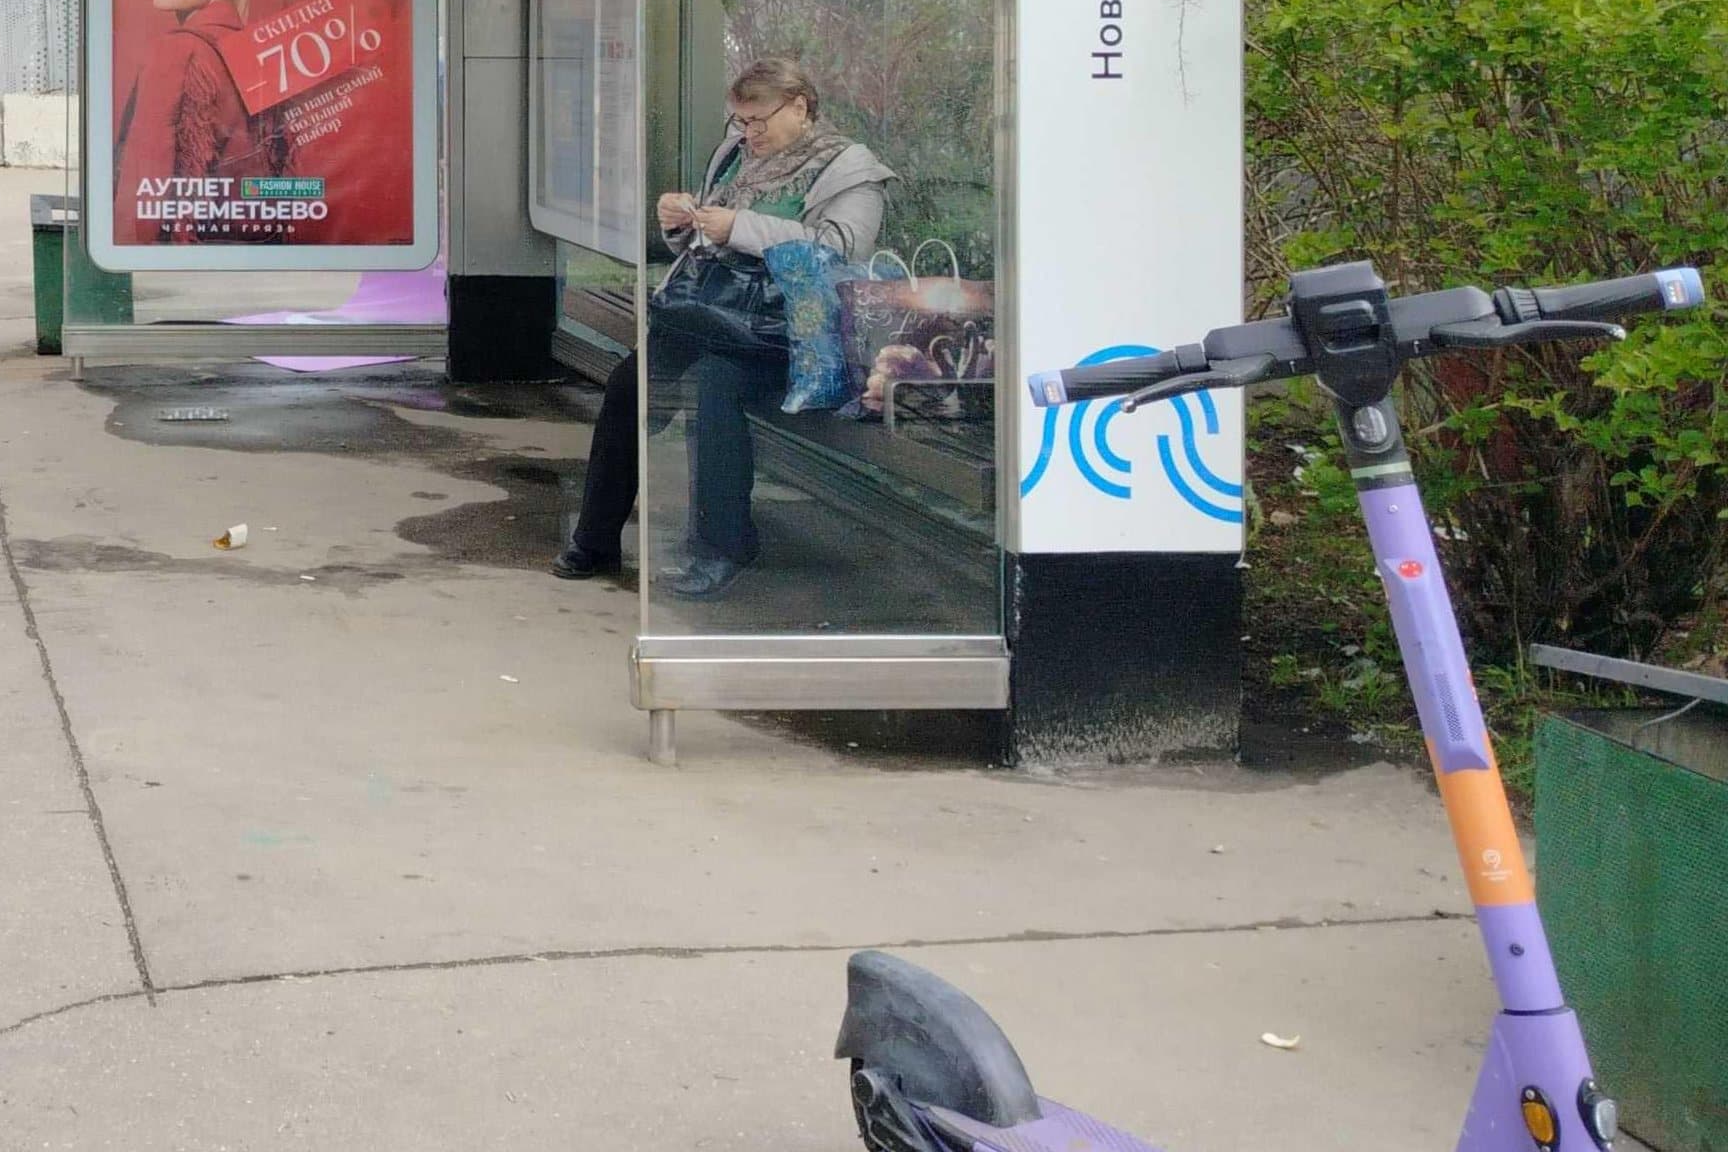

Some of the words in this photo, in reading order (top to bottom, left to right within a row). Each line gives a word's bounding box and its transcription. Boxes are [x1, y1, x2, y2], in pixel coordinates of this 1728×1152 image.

[285, 106, 303, 121] на
[304, 90, 335, 112] наш
[335, 65, 384, 97] самый
[289, 95, 353, 134] большой
[295, 117, 342, 147] выбор
[136, 177, 235, 197] АУТЛЕТ
[260, 179, 292, 191] FASHION
[294, 179, 322, 191] HOUSE
[136, 200, 328, 220] ШЕРЕМЕТЬЕВО
[161, 223, 231, 233] ЧЁРНАЯ
[242, 223, 296, 233] ГРЯЗЬ
